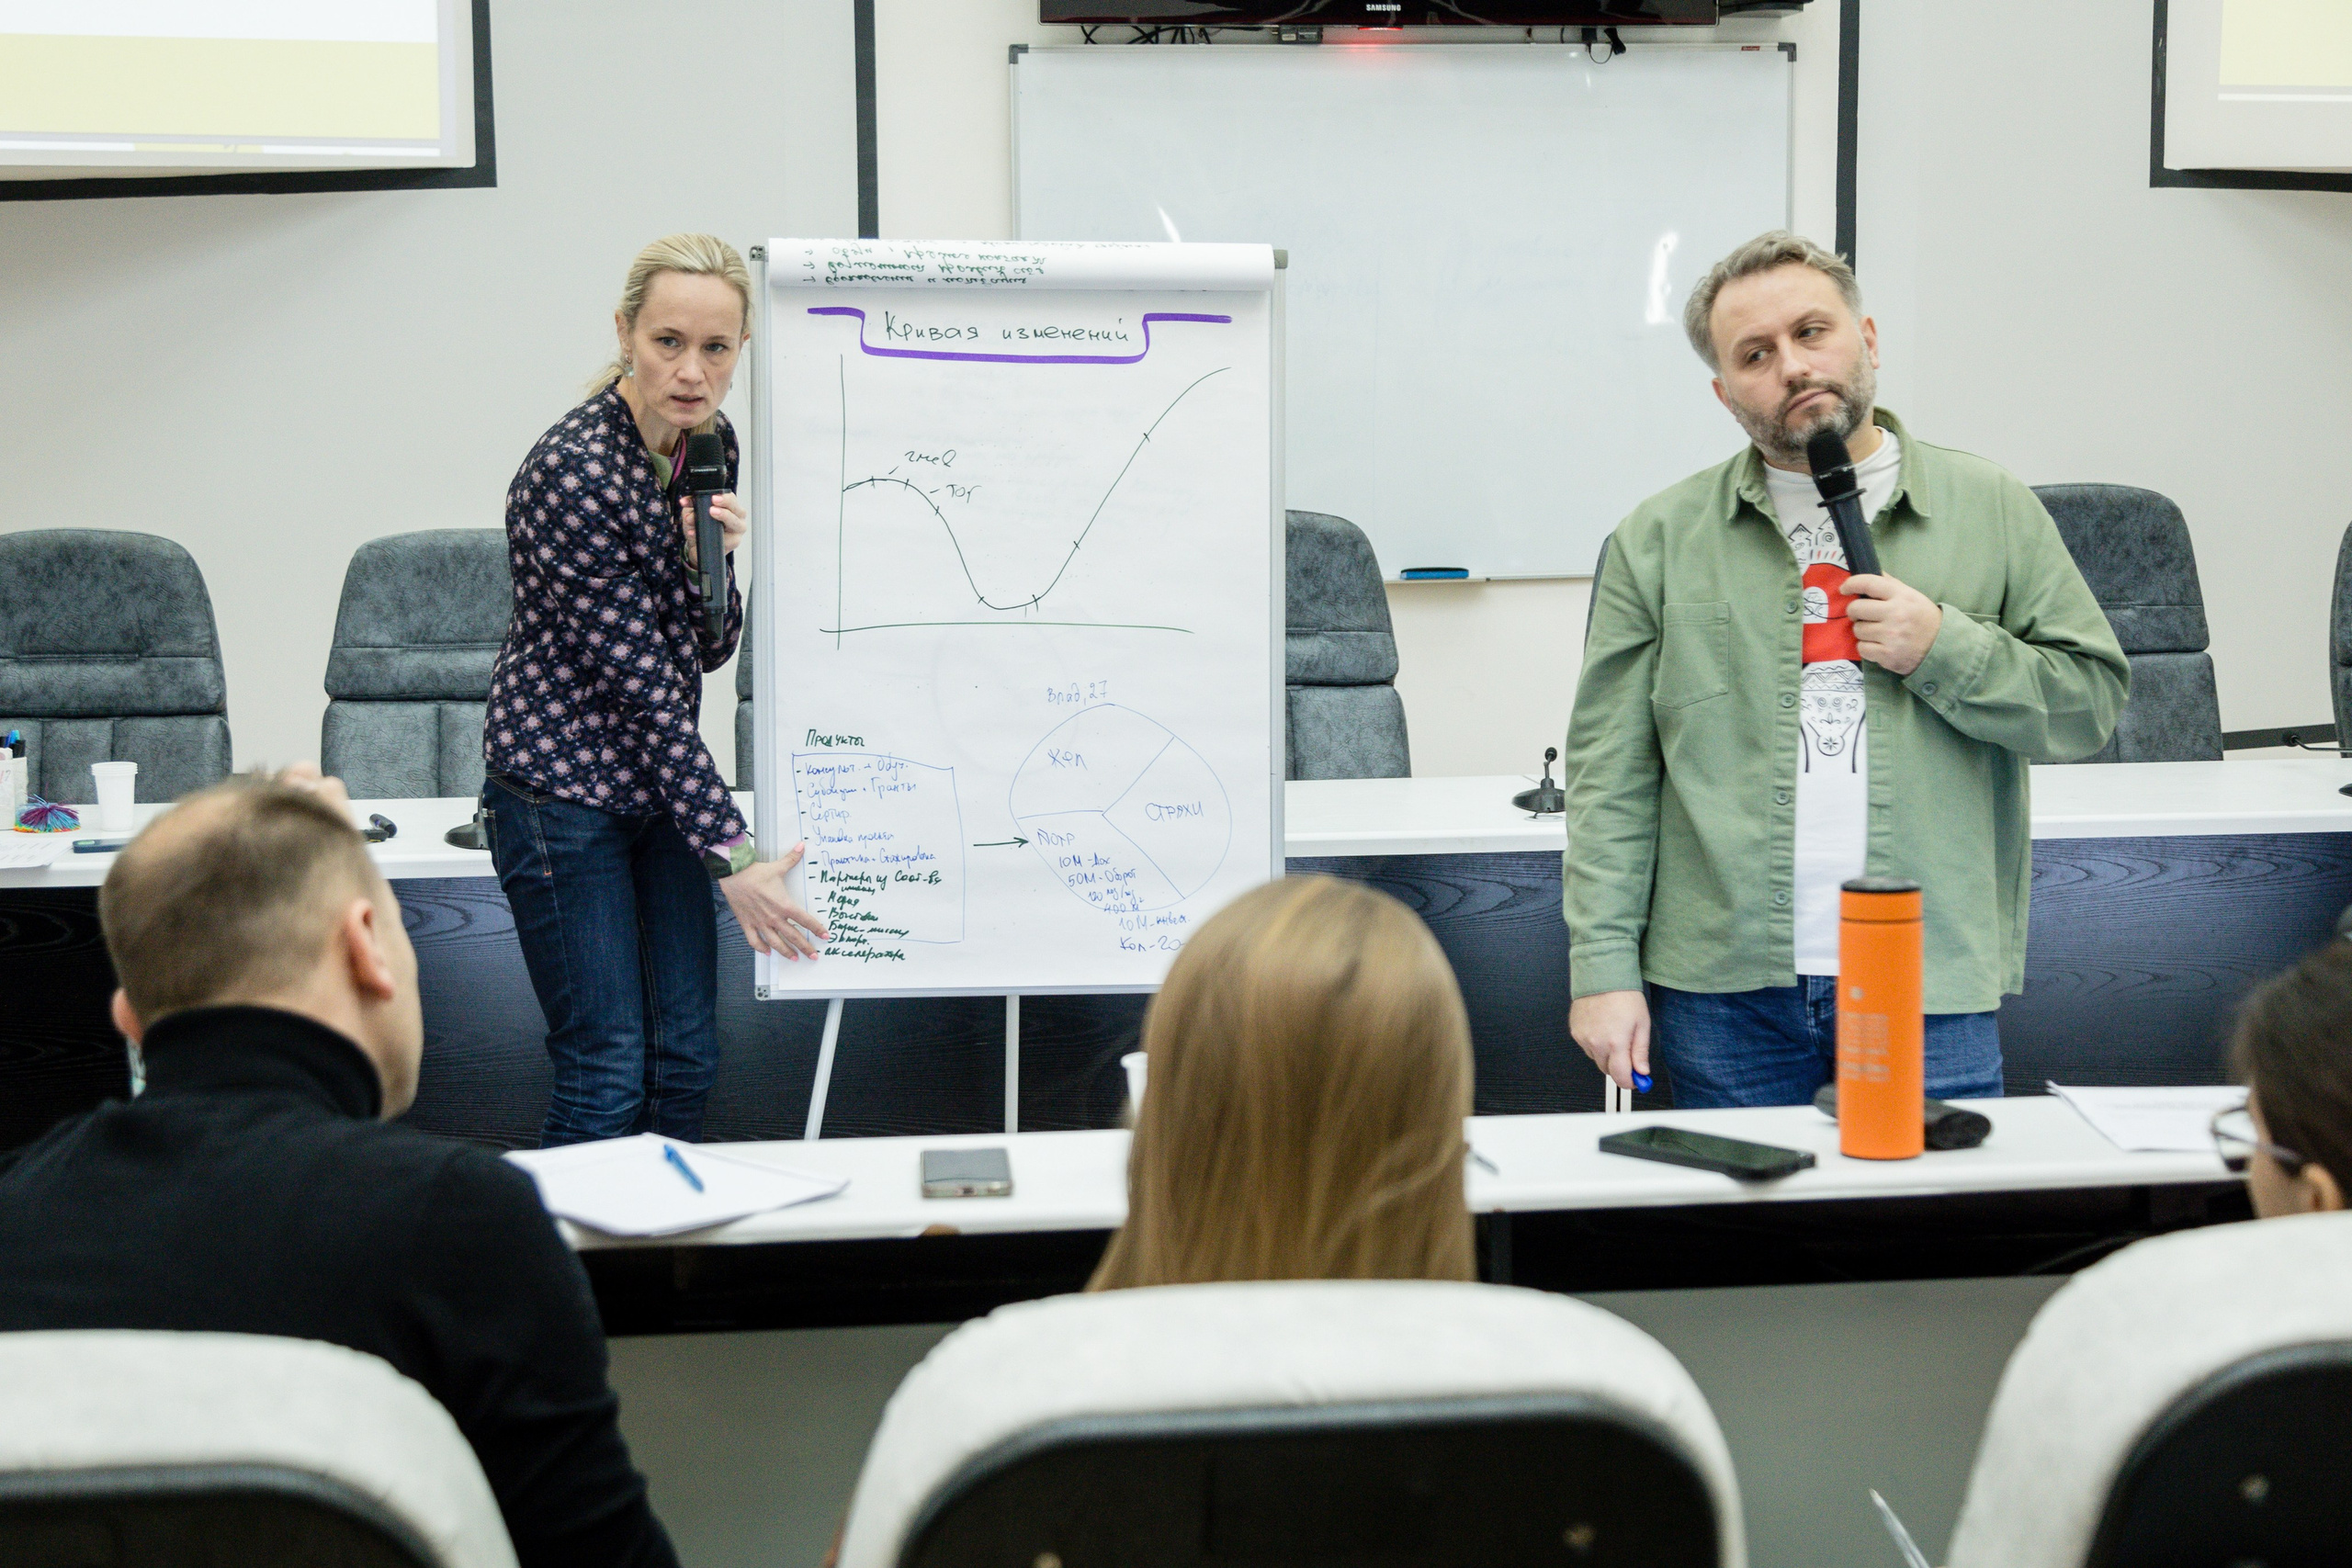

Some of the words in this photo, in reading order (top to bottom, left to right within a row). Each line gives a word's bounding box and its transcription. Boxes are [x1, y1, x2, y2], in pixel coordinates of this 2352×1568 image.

[1366, 4, 1401, 12] SAMSUNG
[885, 310, 978, 341] Кривая
[1002, 318, 1129, 342] изменений
[806, 728, 865, 748] Продукты
[870, 776, 916, 799] Гранты
